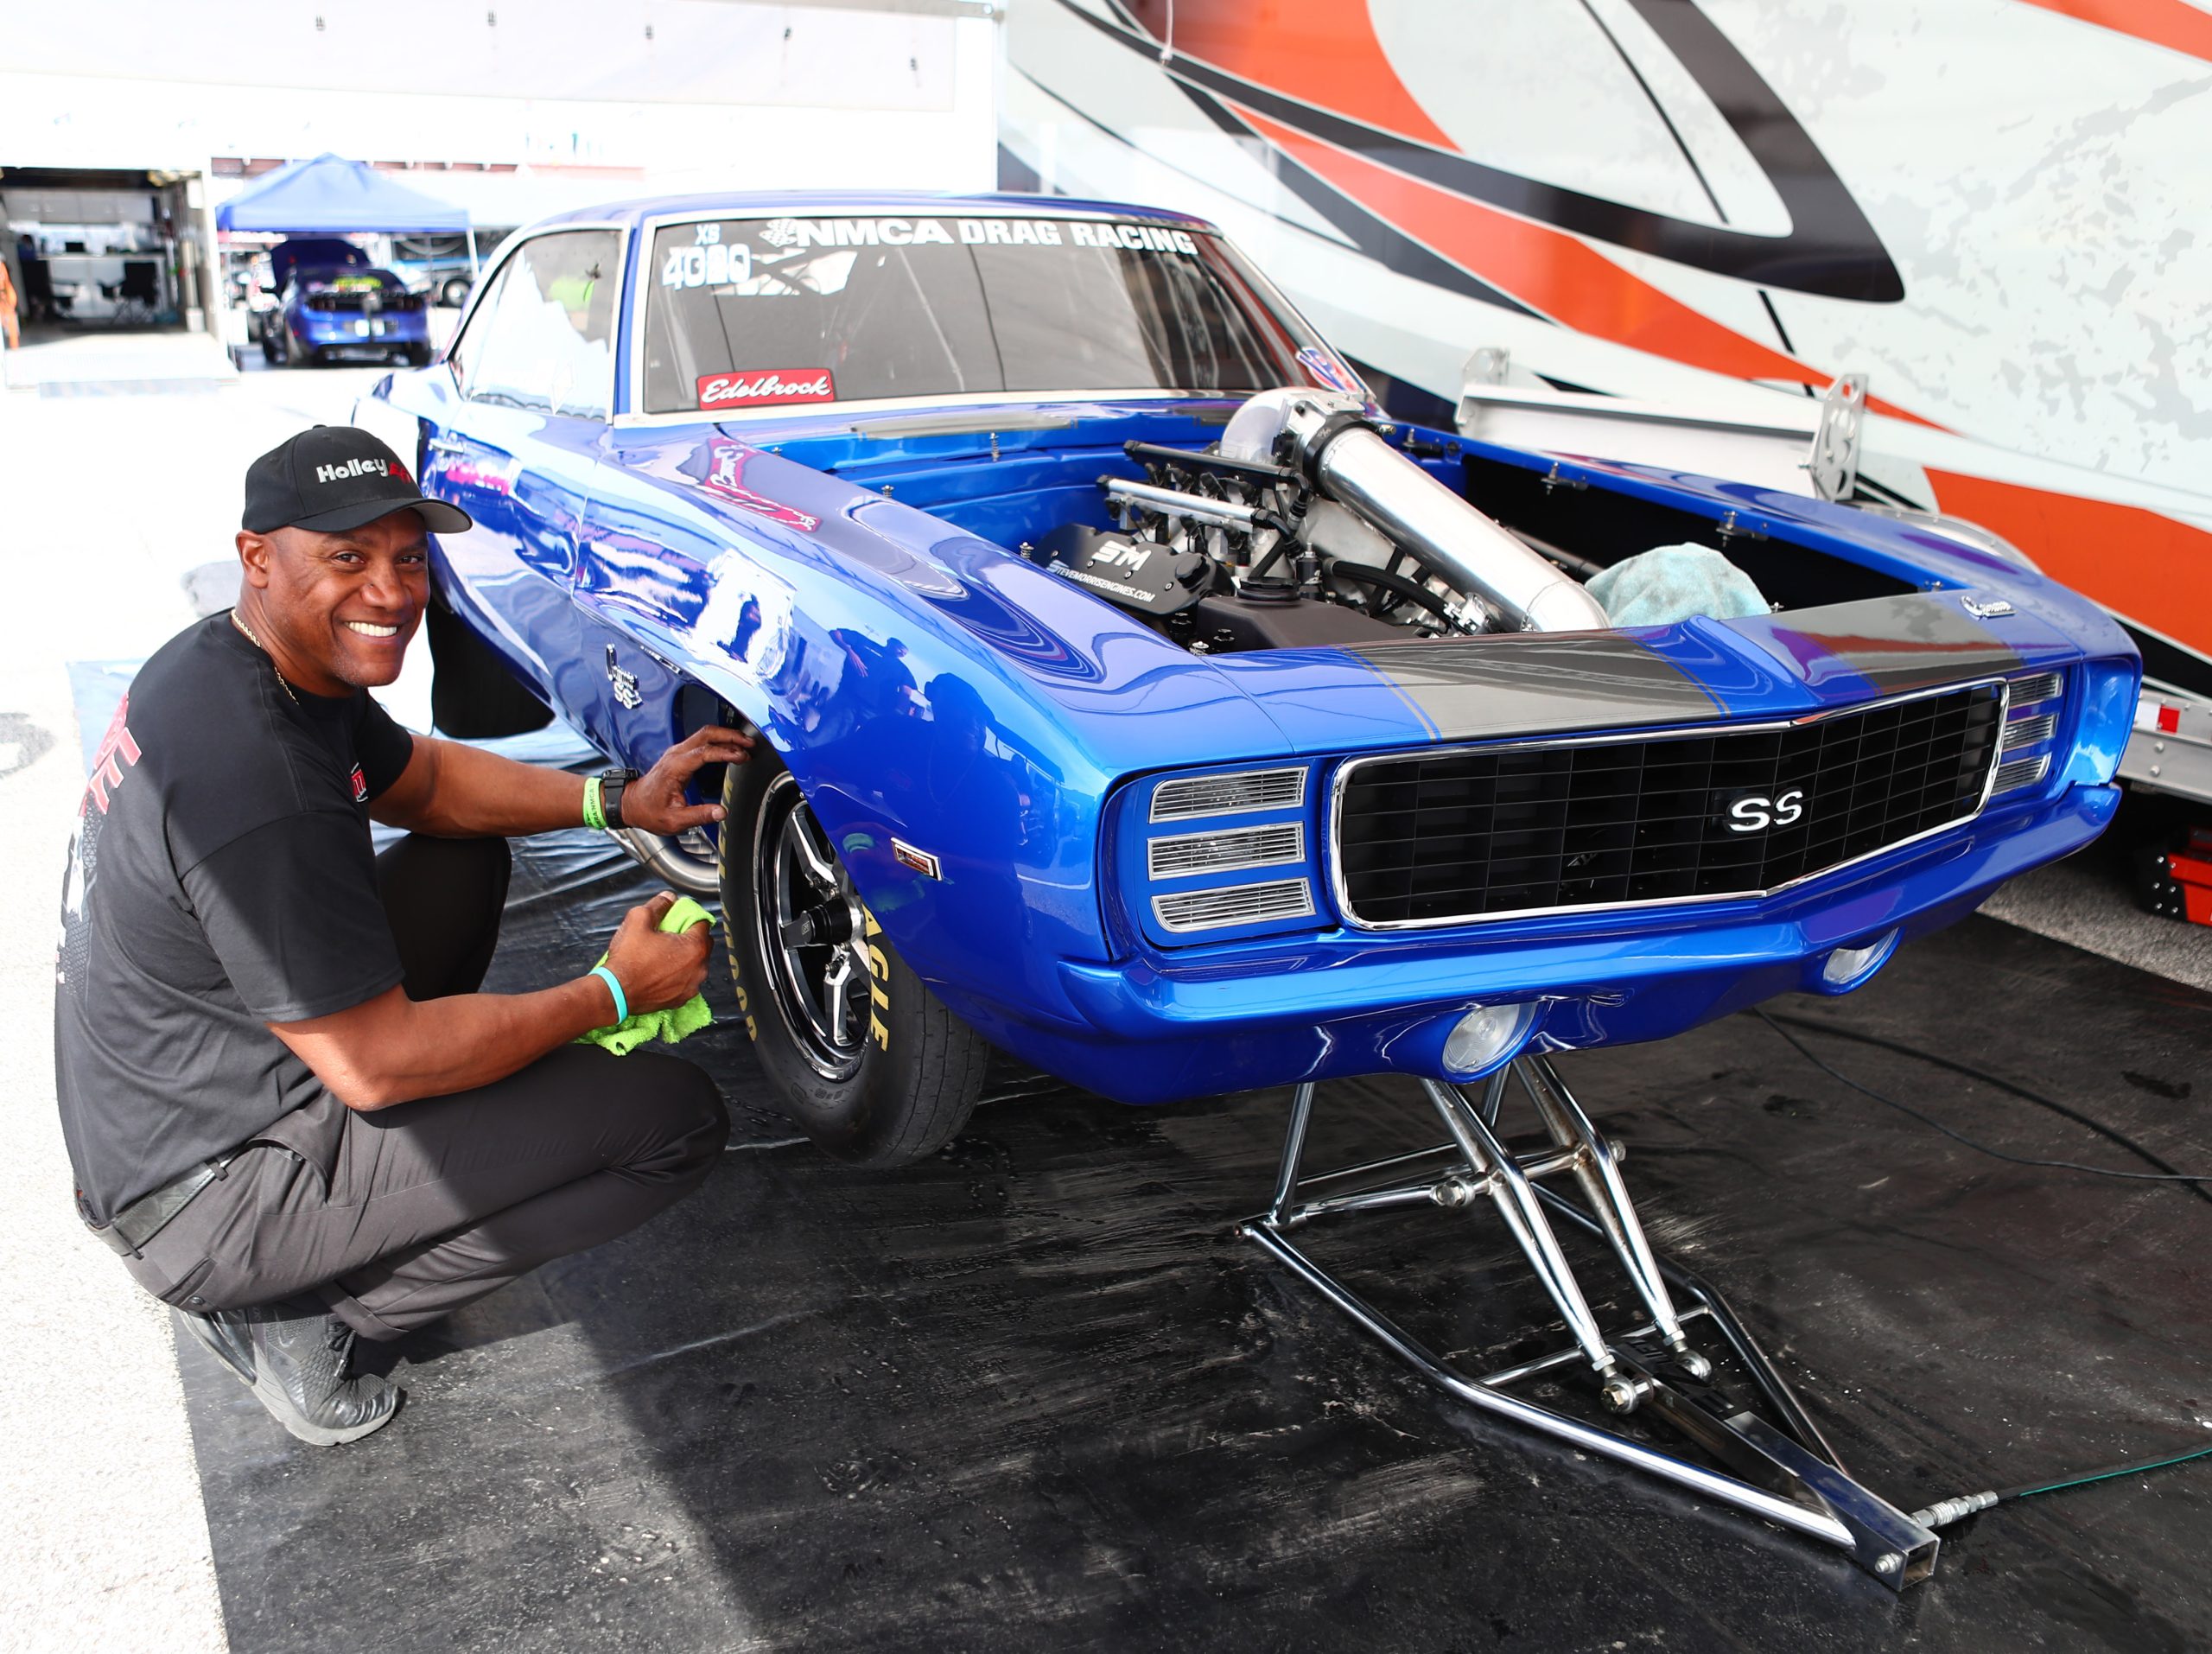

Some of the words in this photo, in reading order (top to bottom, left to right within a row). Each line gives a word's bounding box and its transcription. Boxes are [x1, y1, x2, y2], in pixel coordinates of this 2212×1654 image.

[797, 219, 955, 248] NMCA
[957, 219, 1063, 245] DRAG
[1069, 222, 1198, 255] RACING
[701, 374, 830, 404] Edelbrock
[315, 458, 389, 483] Holley
[1046, 559, 1155, 602] STEVEMORRISENGINES.COM
[1728, 790, 1803, 831] SS
[861, 902, 890, 1052] AGLE
